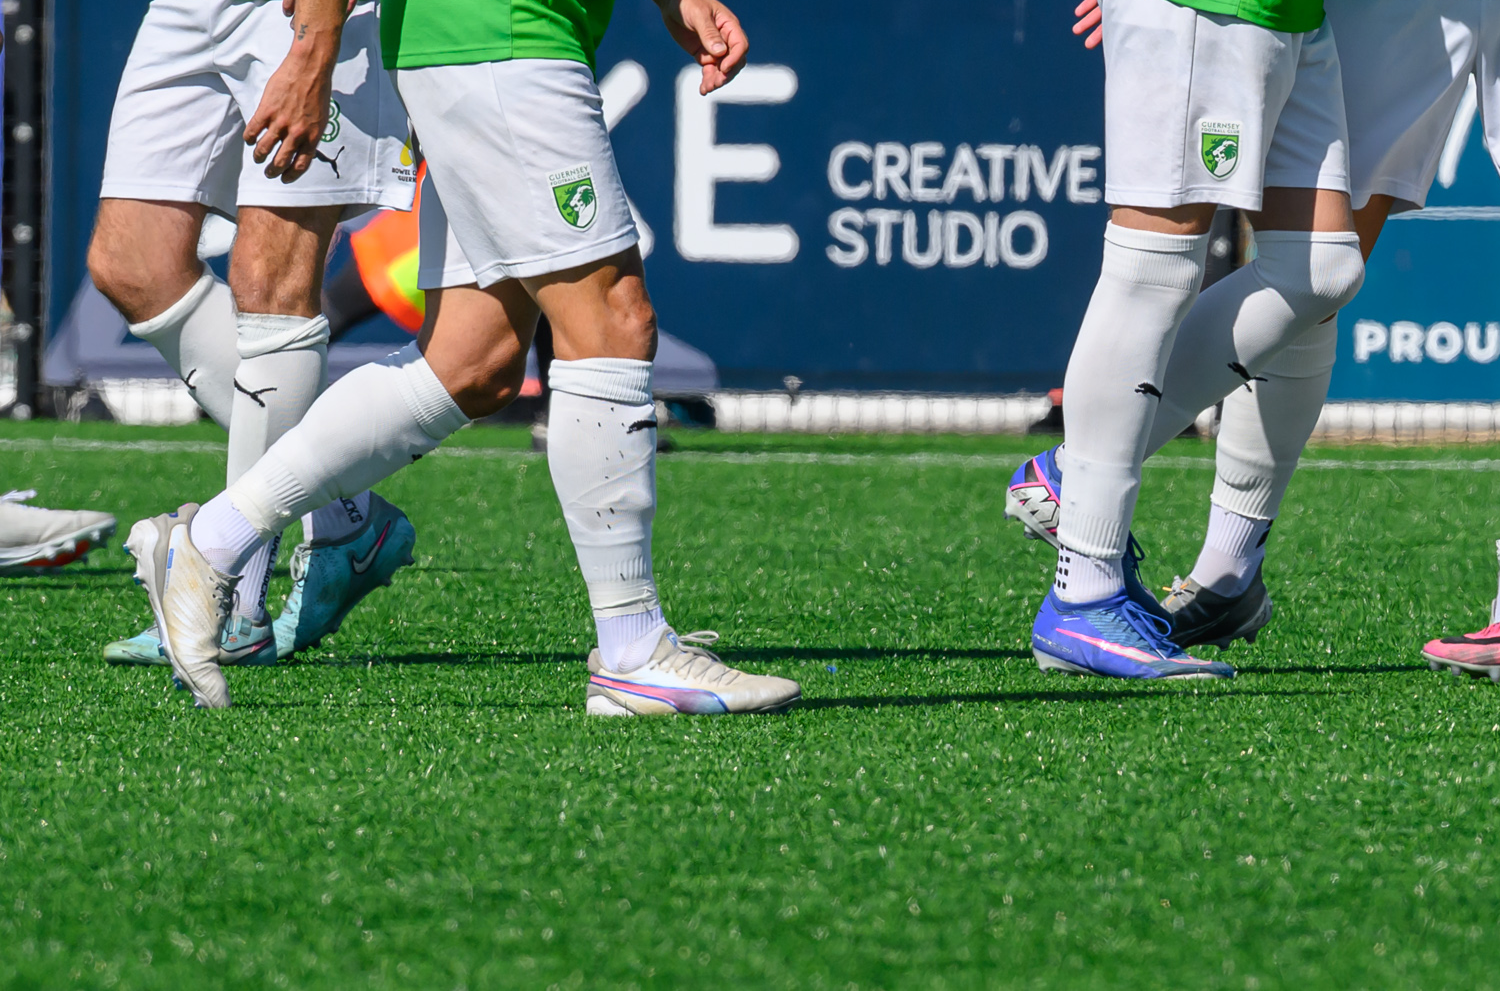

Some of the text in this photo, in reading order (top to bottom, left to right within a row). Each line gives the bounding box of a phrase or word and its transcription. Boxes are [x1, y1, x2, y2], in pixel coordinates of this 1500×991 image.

[549, 165, 588, 181] GUERNSEY
[827, 140, 1102, 204] CREATIVE
[825, 207, 1049, 269] STUDIO
